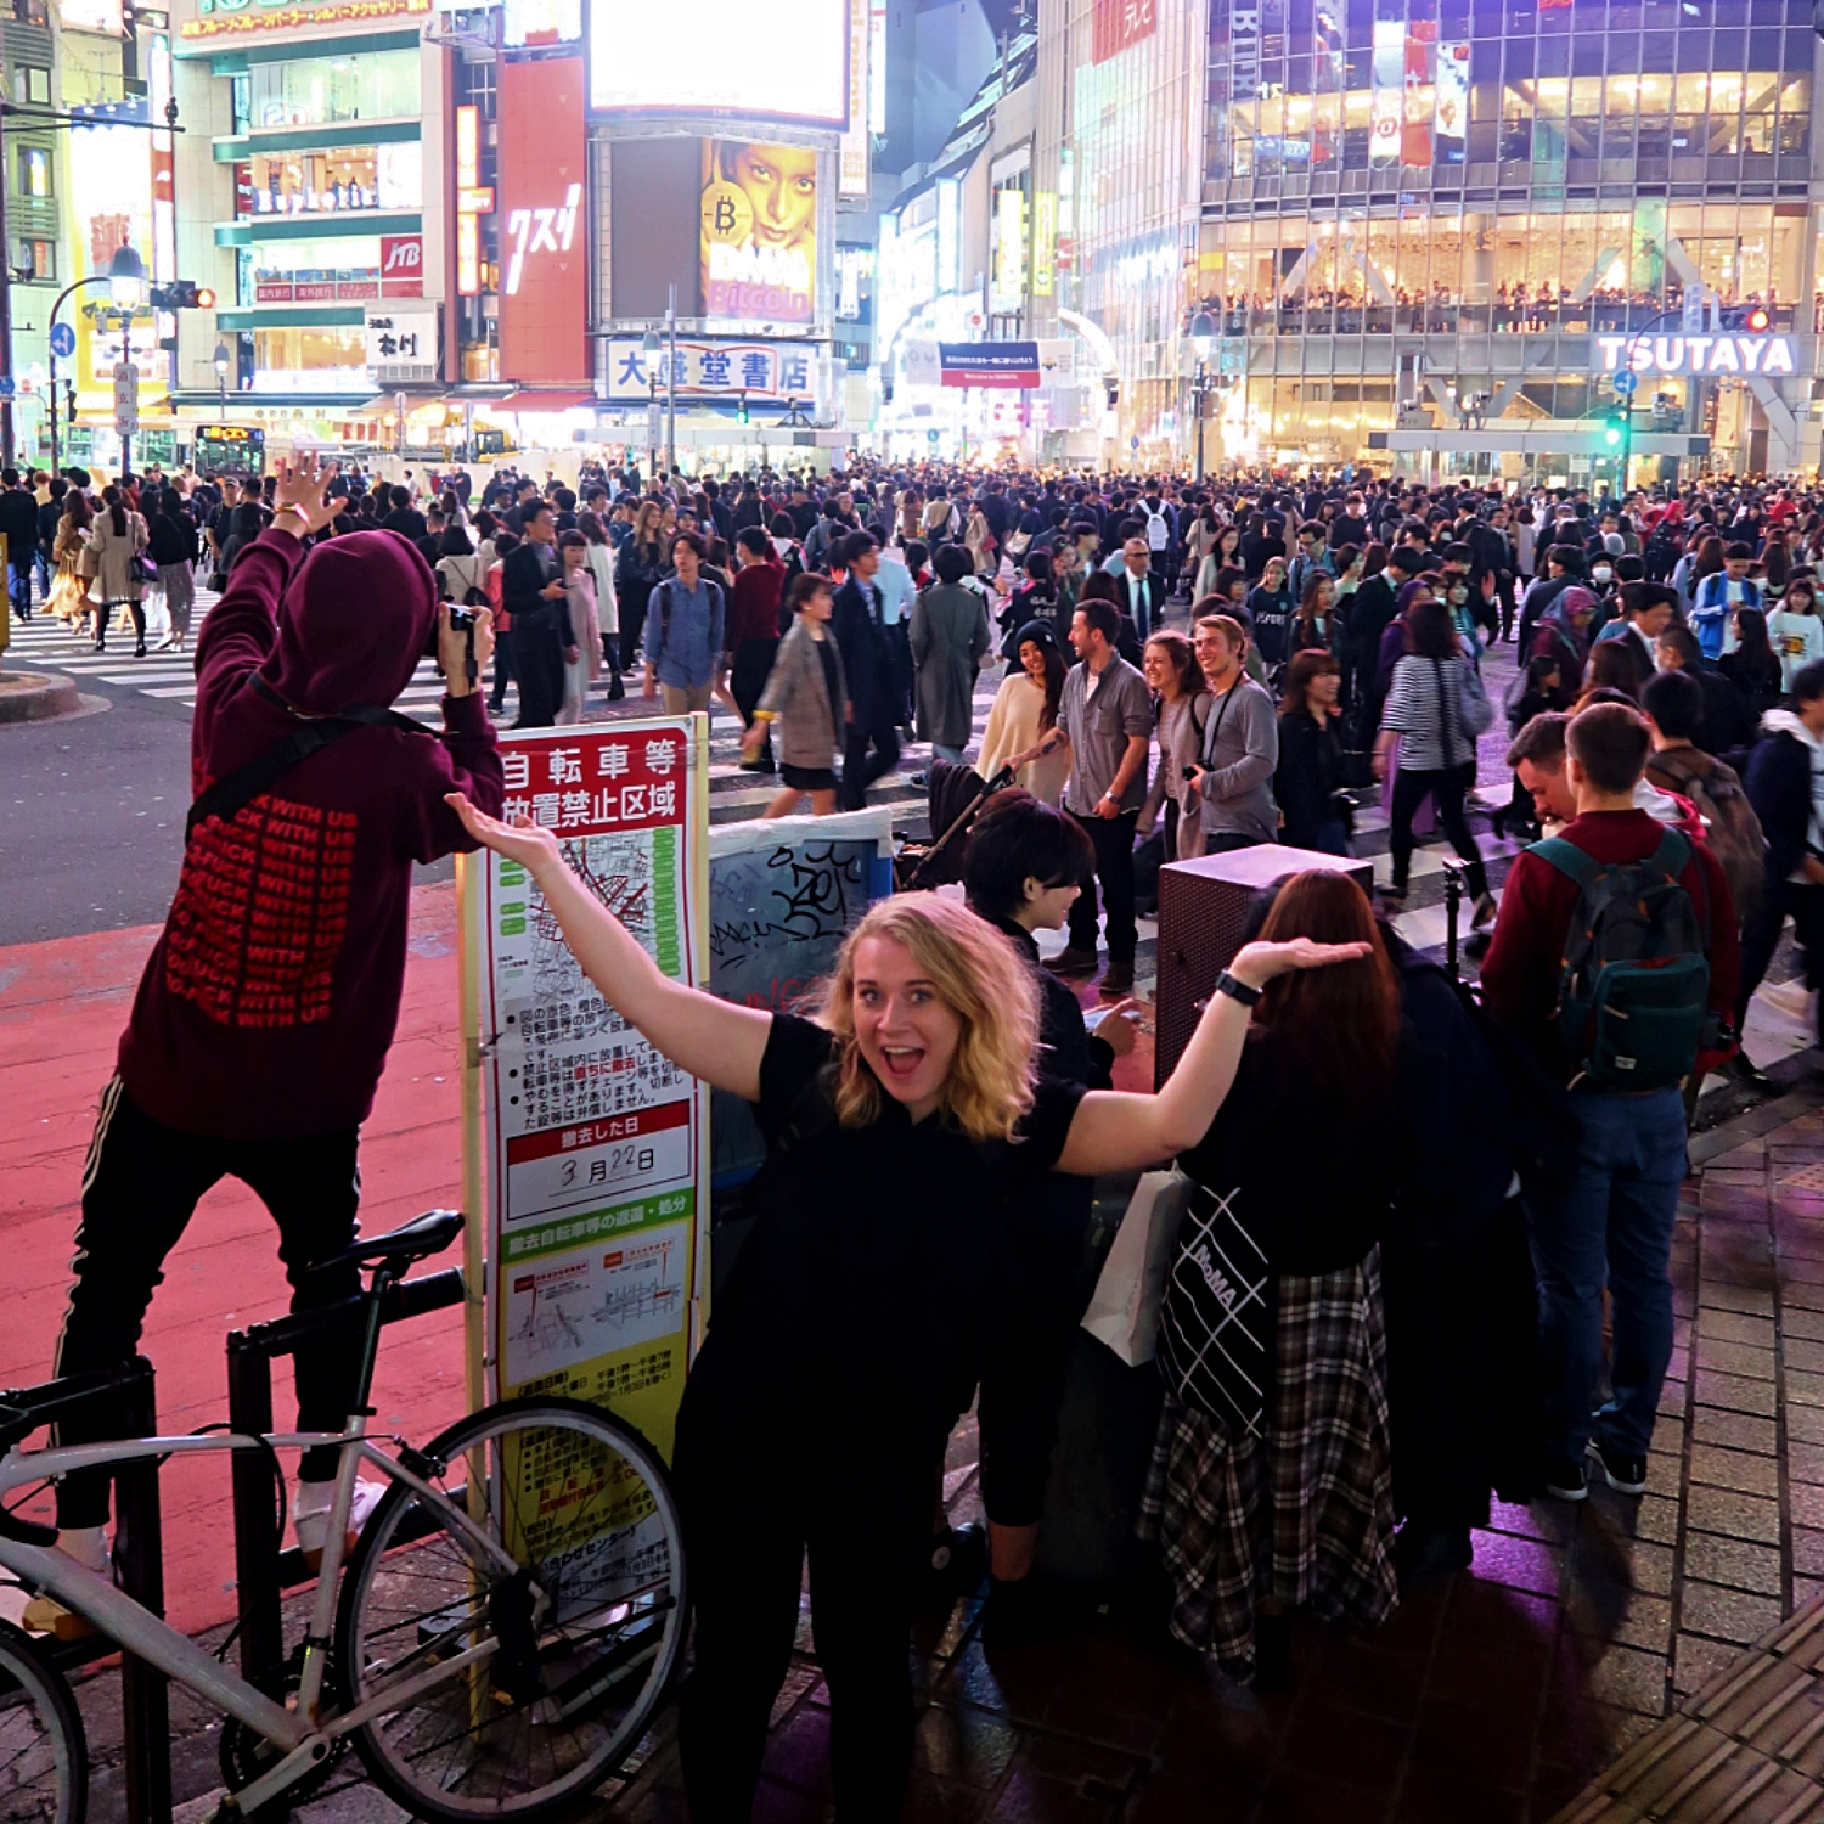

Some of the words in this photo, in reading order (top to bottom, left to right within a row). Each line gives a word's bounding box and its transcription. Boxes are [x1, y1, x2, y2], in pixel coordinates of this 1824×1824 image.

[506, 183, 582, 295] クスリ
[384, 242, 421, 272] JTB
[708, 280, 808, 312] Bitcoin
[1597, 336, 1793, 372] TSUTAYA
[501, 738, 677, 790] 自転車等
[271, 797, 322, 824] WITH
[500, 780, 676, 829] 放置禁止区域
[235, 806, 264, 829] CK
[266, 817, 319, 844] WITH
[262, 836, 317, 863] WITH
[261, 854, 316, 881] WITH
[257, 871, 313, 900] WITH
[253, 890, 312, 917] WITH
[246, 945, 306, 964] WITH
[236, 1011, 295, 1028] WITH
[561, 1116, 639, 1149] 撤去した日
